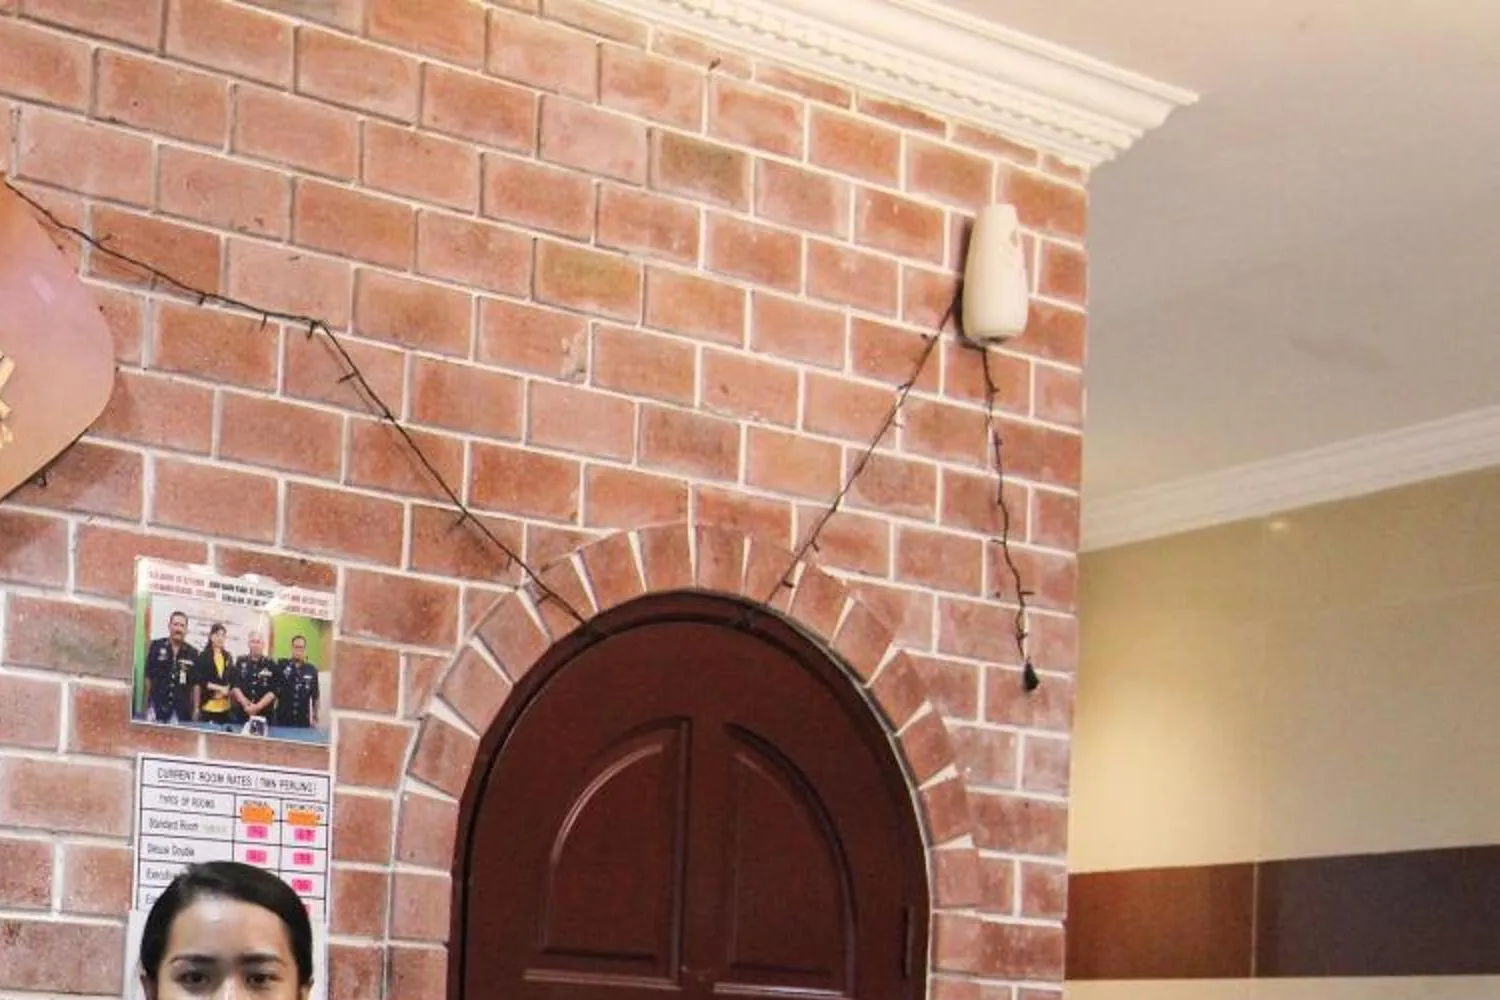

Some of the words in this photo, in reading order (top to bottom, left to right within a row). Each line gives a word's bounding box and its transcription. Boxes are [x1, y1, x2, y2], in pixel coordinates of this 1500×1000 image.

[157, 767, 196, 782] CURRENT
[199, 771, 225, 784] ROOM
[227, 774, 252, 787] RATES
[149, 818, 178, 831] Standard
[180, 820, 199, 832] Room
